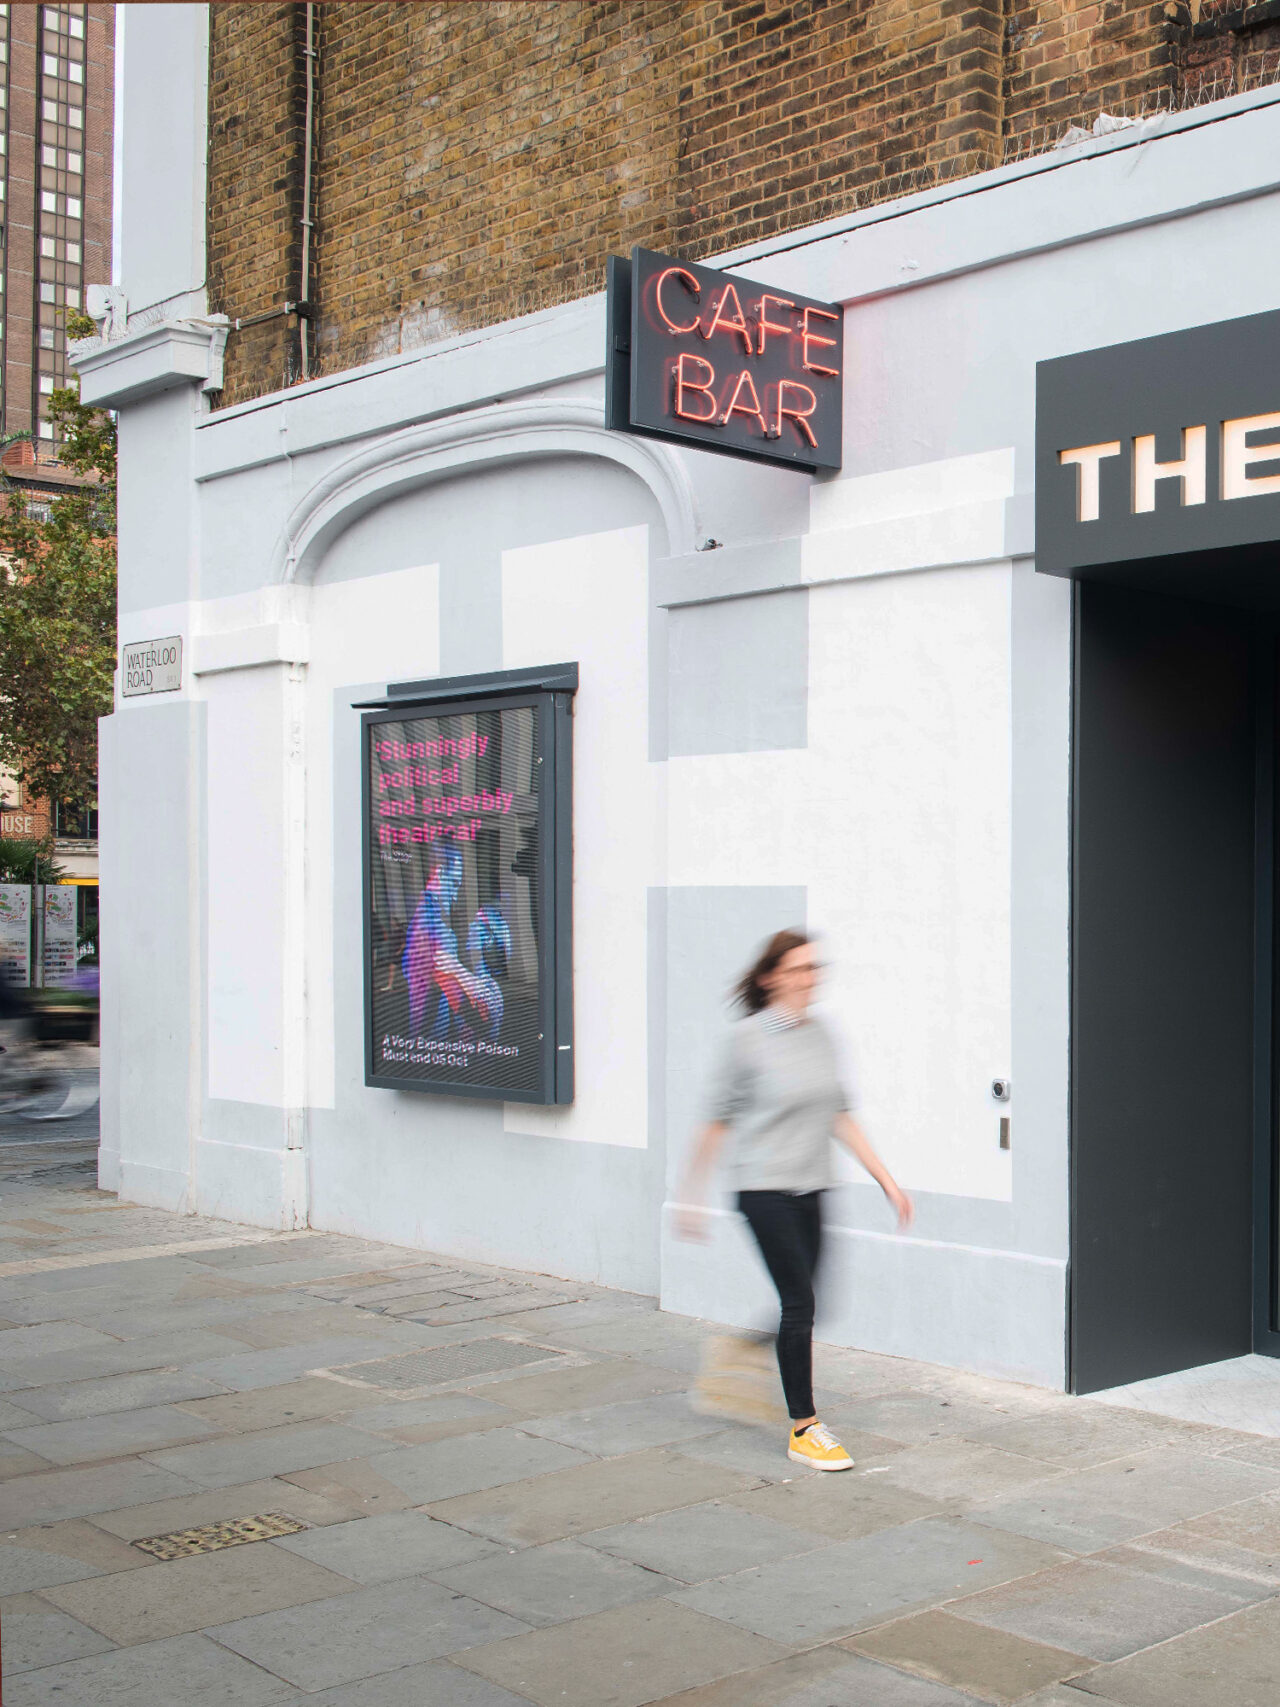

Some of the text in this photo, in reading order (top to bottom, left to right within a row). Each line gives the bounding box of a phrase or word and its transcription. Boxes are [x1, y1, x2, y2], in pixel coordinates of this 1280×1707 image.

[657, 267, 839, 375] CAFE
[676, 353, 819, 448] BAR
[127, 647, 177, 670] WATERLOO
[127, 669, 153, 689] ROAD
[379, 762, 459, 793] political
[378, 787, 513, 817] and superbly
[382, 1034, 519, 1056] A Very Expensive Poison
[382, 1047, 468, 1067] Must end 05 Oct
